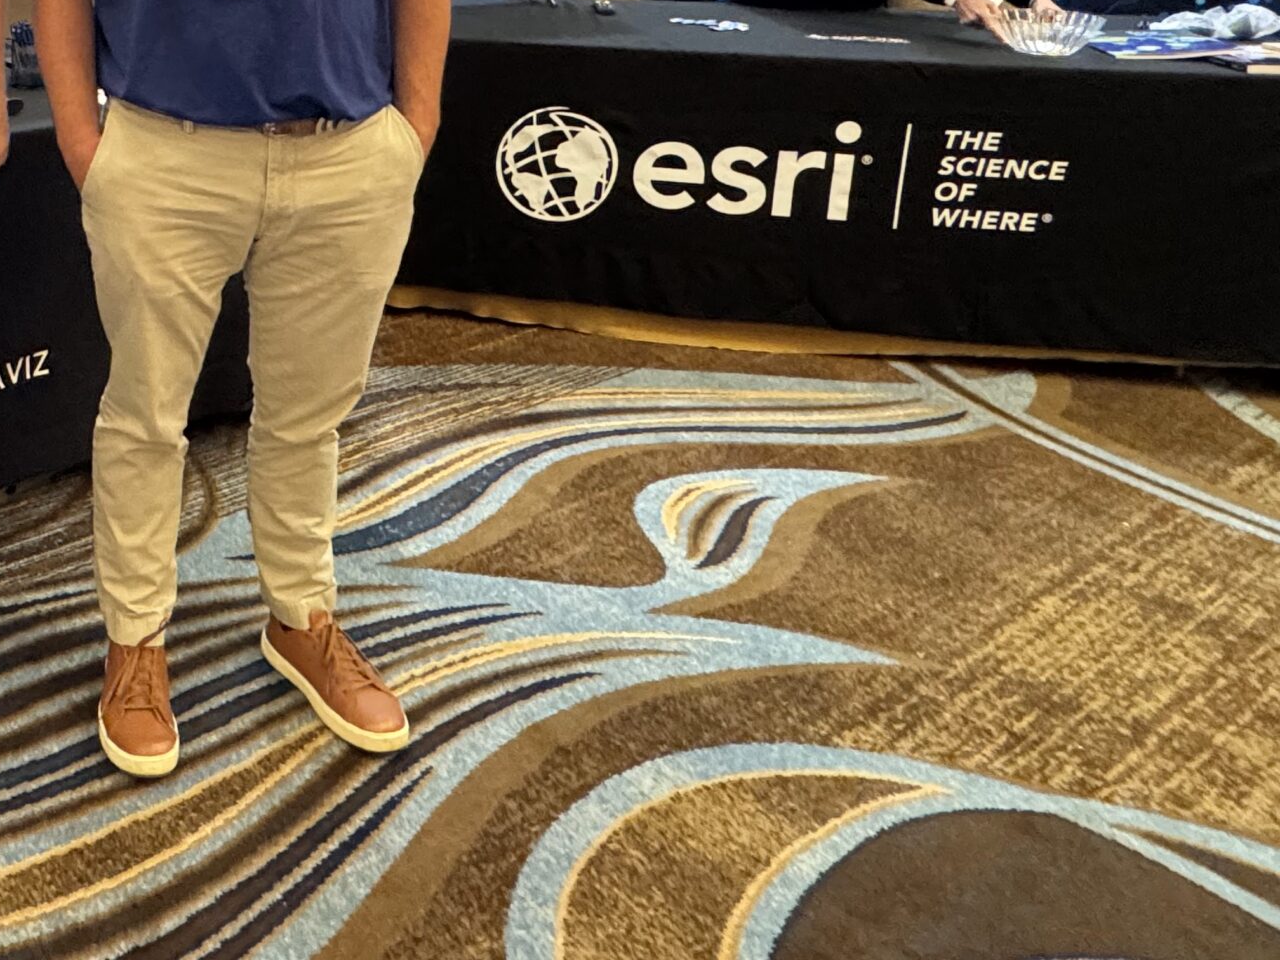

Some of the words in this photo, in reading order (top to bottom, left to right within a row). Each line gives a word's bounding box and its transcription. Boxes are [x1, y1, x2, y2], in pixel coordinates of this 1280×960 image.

[944, 129, 1003, 152] THE
[633, 121, 862, 221] esri
[937, 155, 1069, 181] SCIENCE
[934, 182, 978, 202] OF
